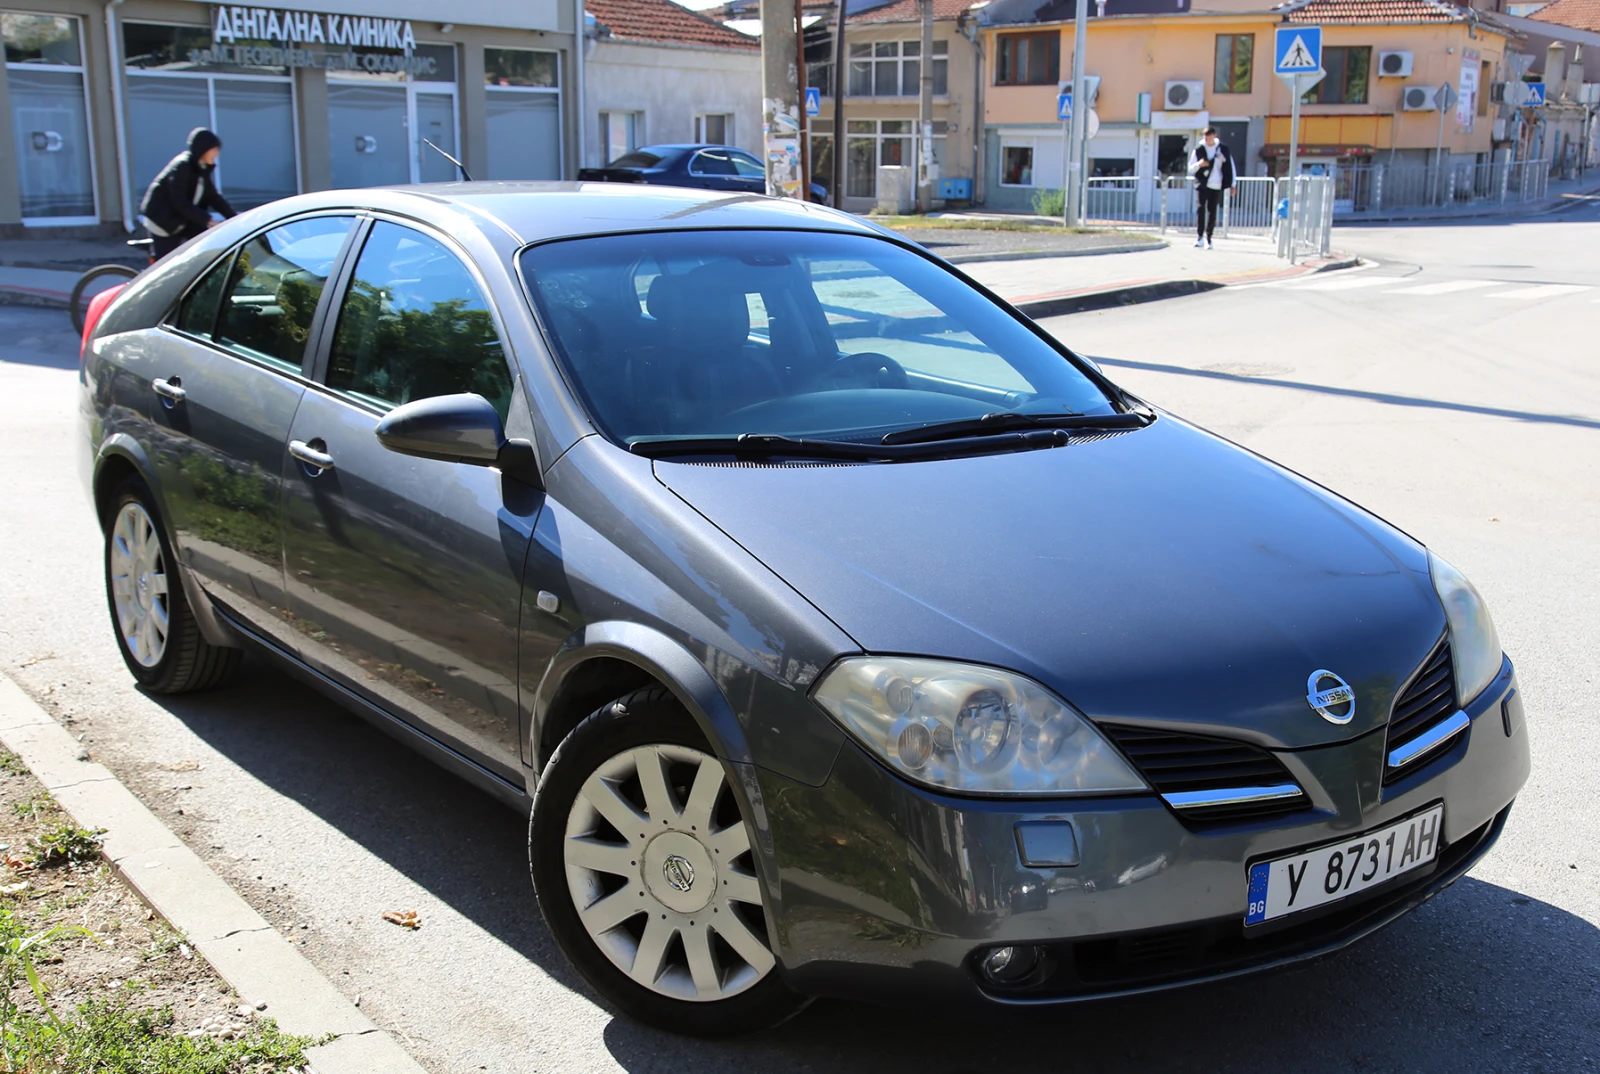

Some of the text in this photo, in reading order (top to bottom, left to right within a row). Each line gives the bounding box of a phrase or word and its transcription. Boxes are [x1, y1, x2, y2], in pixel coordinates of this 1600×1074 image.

[215, 6, 416, 50] ДЕНТАЛНА КЛИНИКА
[1315, 688, 1354, 705] NISSAN
[1324, 831, 1397, 895] 8731
[1249, 900, 1265, 916] BG
